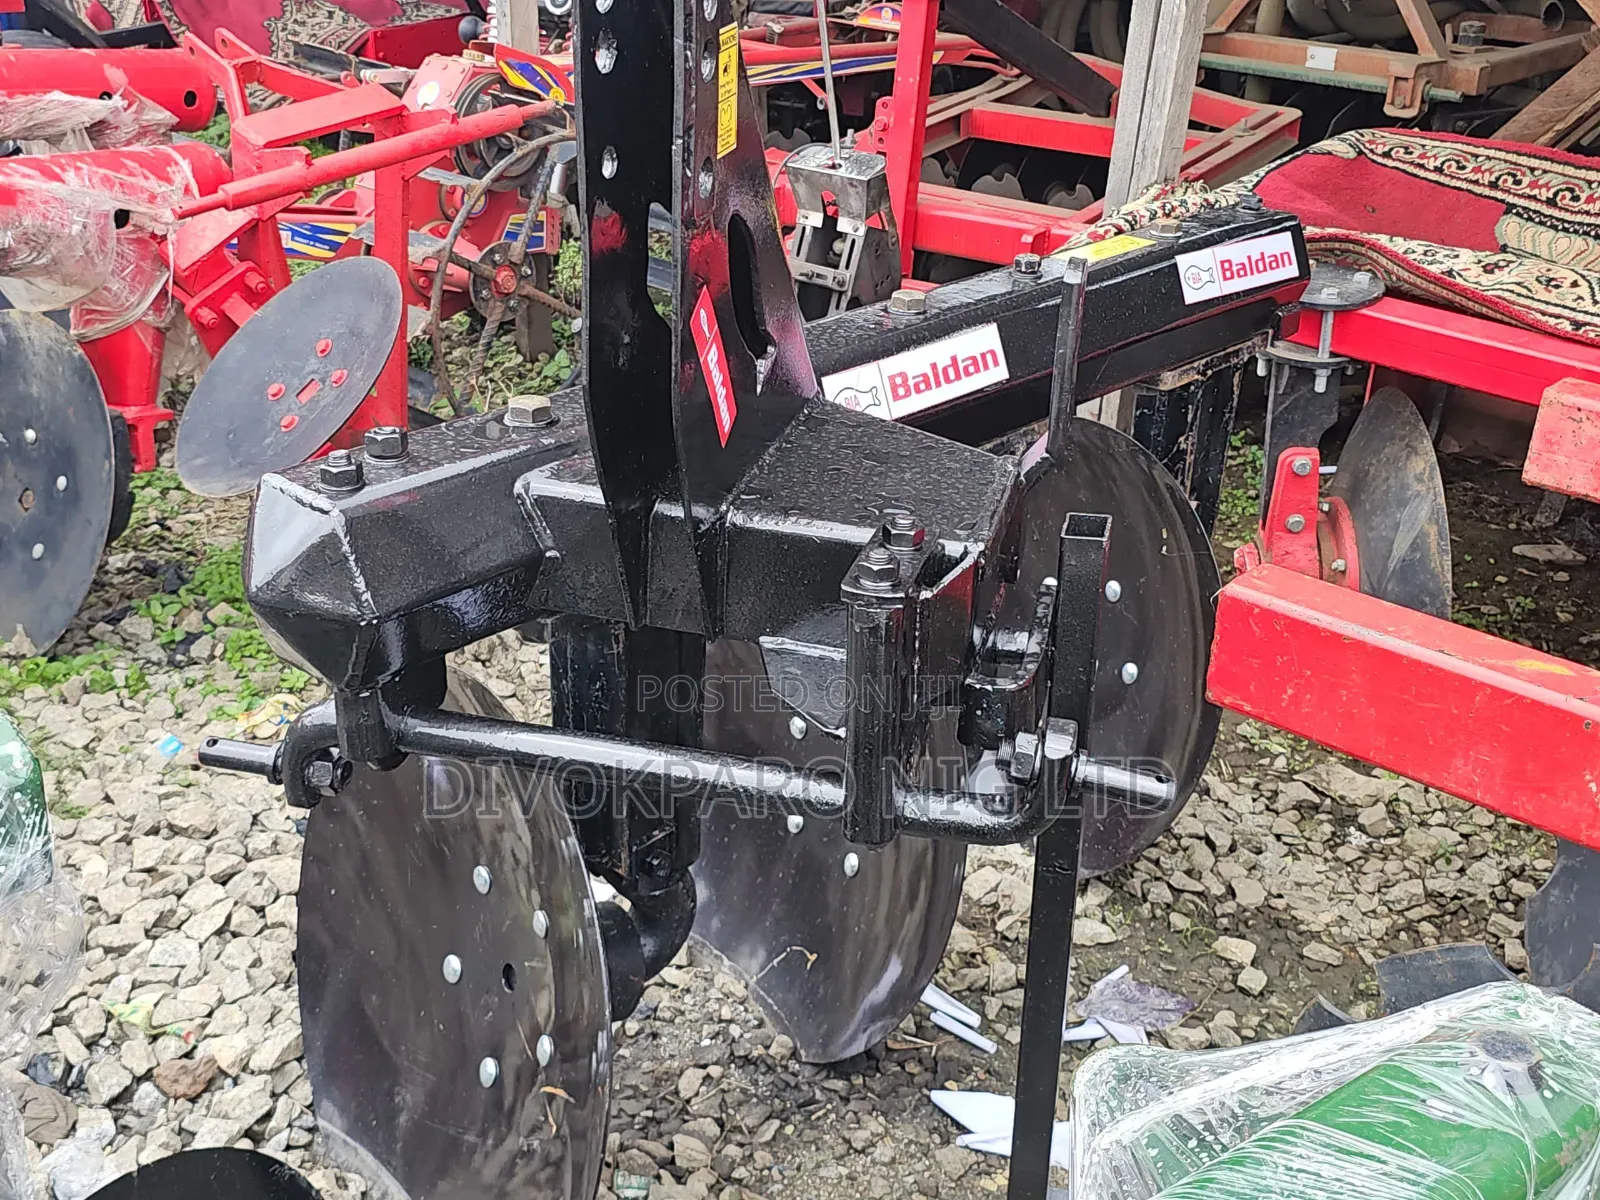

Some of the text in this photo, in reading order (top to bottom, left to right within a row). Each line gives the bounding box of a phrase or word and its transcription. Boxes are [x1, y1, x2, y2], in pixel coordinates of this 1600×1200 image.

[1220, 251, 1293, 282] Baldan
[707, 343, 731, 434] Baldan
[887, 348, 1000, 402] Baldan
